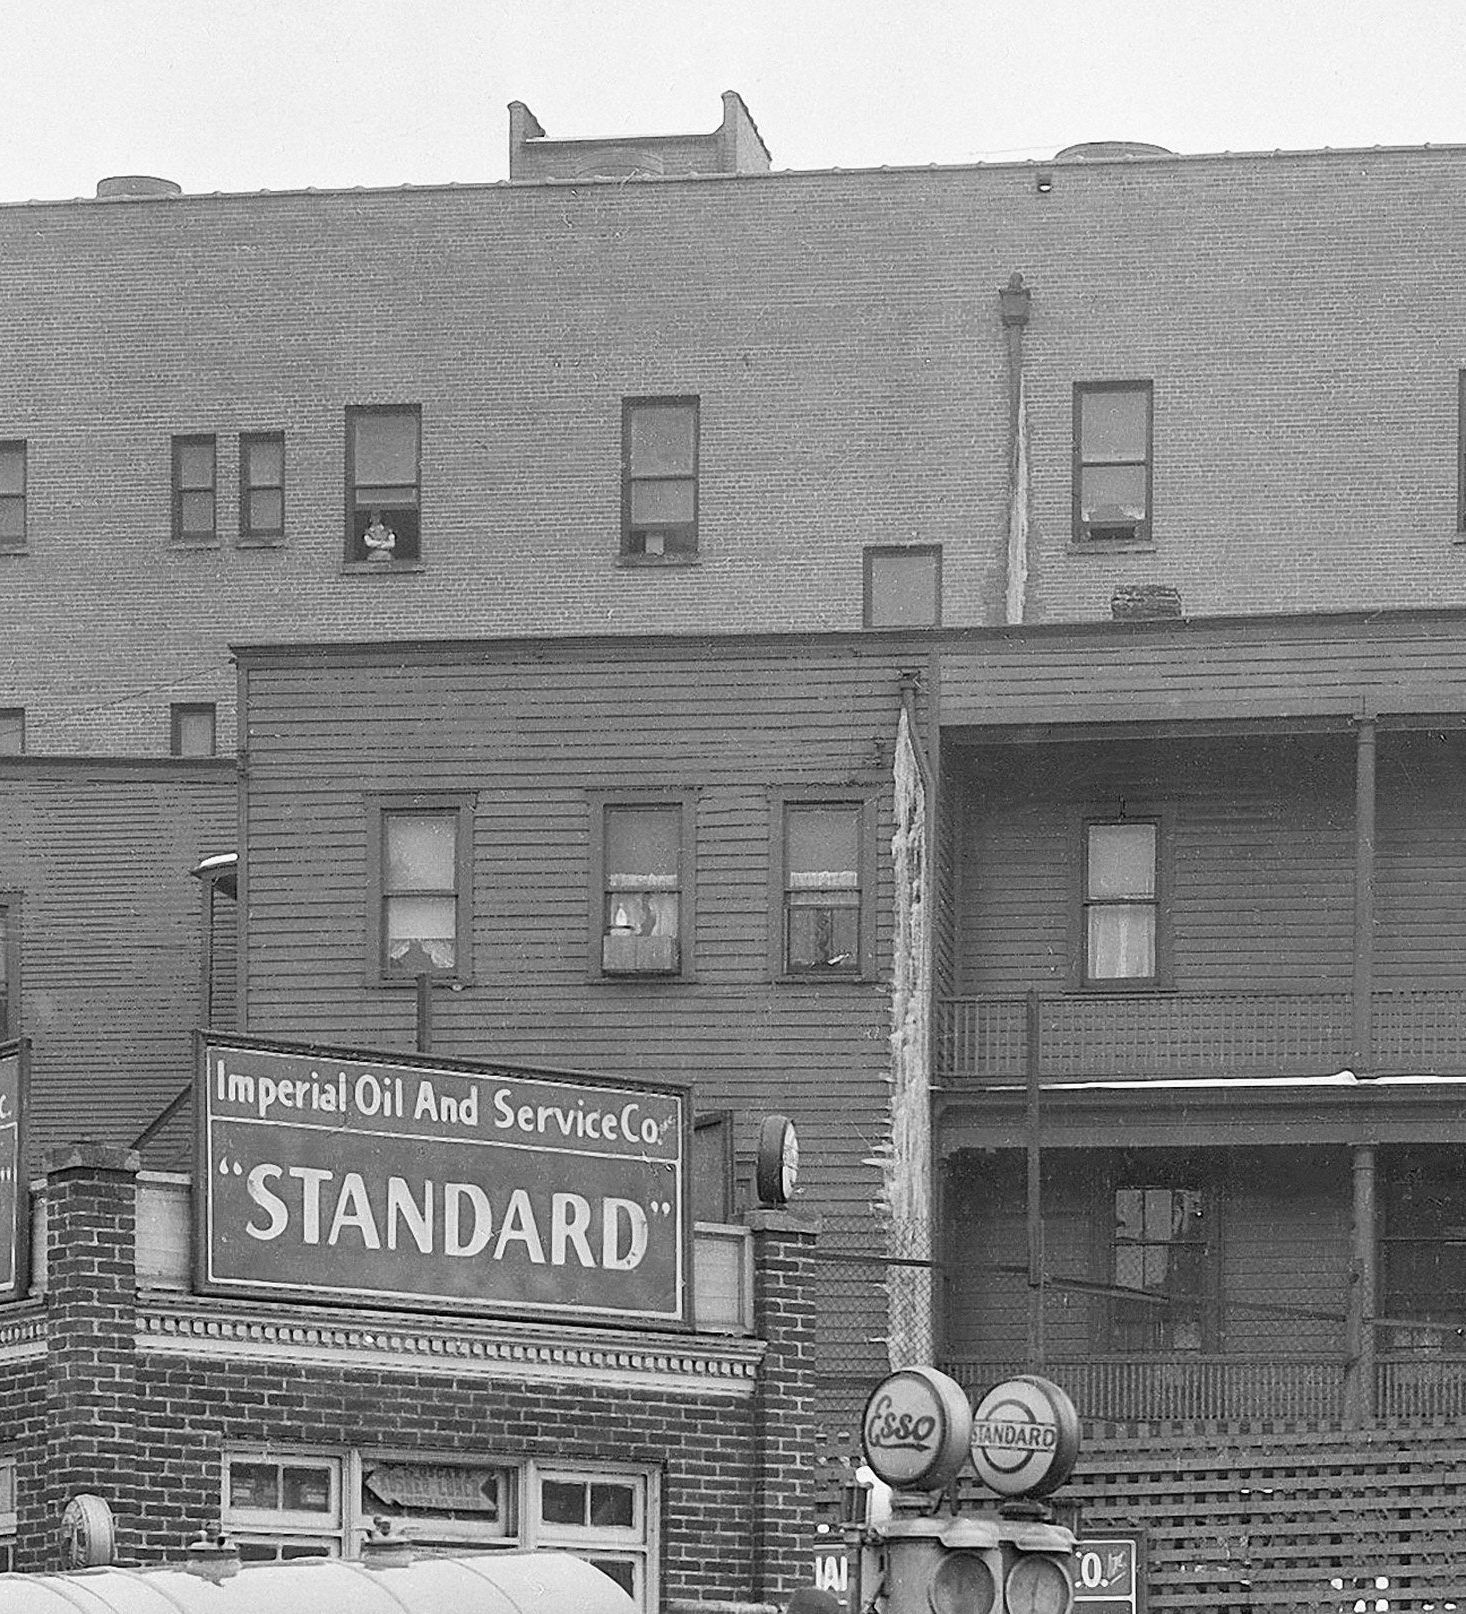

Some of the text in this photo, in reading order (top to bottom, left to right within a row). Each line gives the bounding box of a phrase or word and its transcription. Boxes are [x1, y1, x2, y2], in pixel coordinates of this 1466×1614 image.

[216, 1059, 348, 1117] Imperial
[355, 1073, 404, 1118] Oil
[415, 1080, 479, 1127] And
[494, 1088, 618, 1141] Service
[218, 1156, 672, 1271] "STANDARD"
